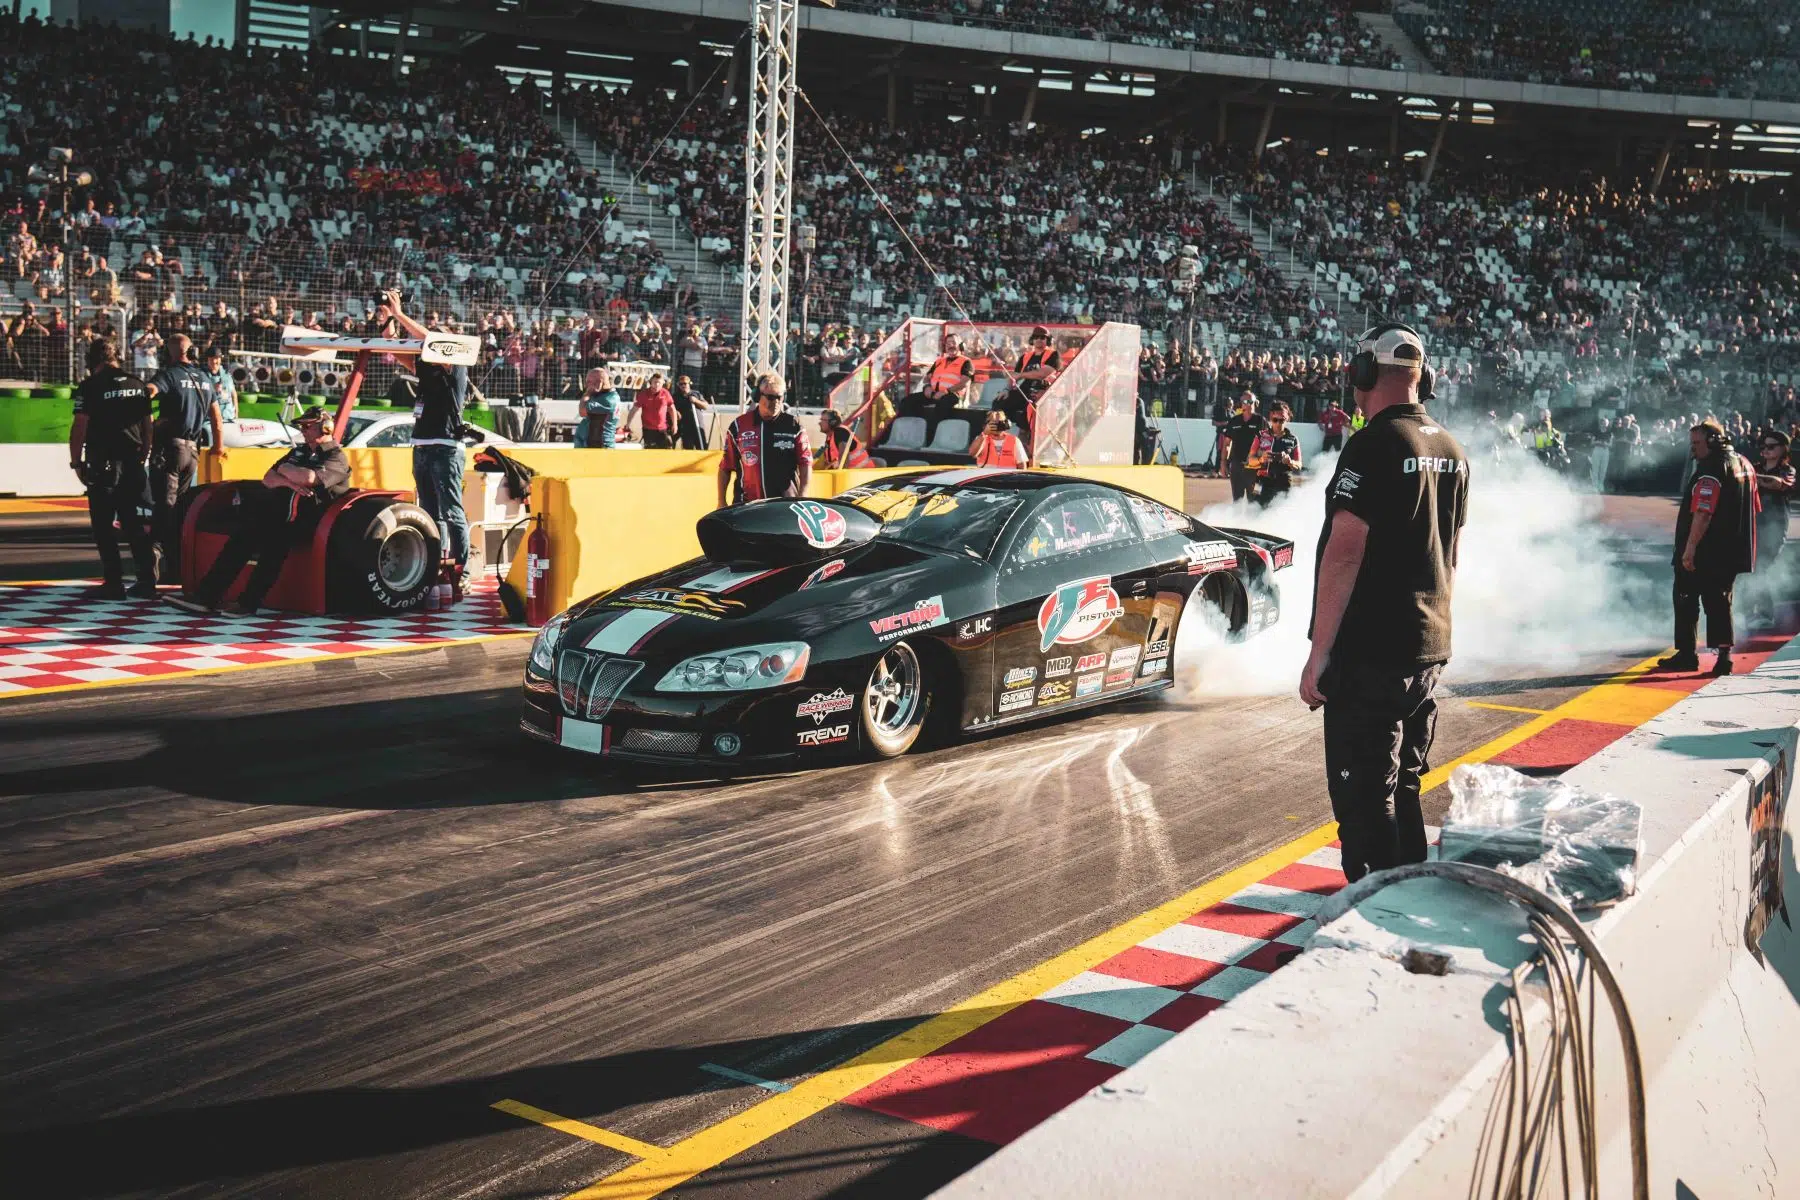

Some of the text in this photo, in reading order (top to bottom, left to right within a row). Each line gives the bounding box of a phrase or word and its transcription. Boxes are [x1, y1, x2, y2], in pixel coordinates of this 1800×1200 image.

[789, 500, 829, 543] VP
[367, 571, 431, 608] GOODYEAR
[869, 604, 942, 635] VICTORY
[1079, 609, 1123, 622] PISTONS
[878, 622, 932, 642] PERFORMANCE
[975, 617, 992, 634] IHC
[1046, 658, 1072, 673] MGP
[1077, 653, 1105, 668] ARP
[800, 698, 852, 713] RACE WINNING
[797, 724, 850, 746] TREND
